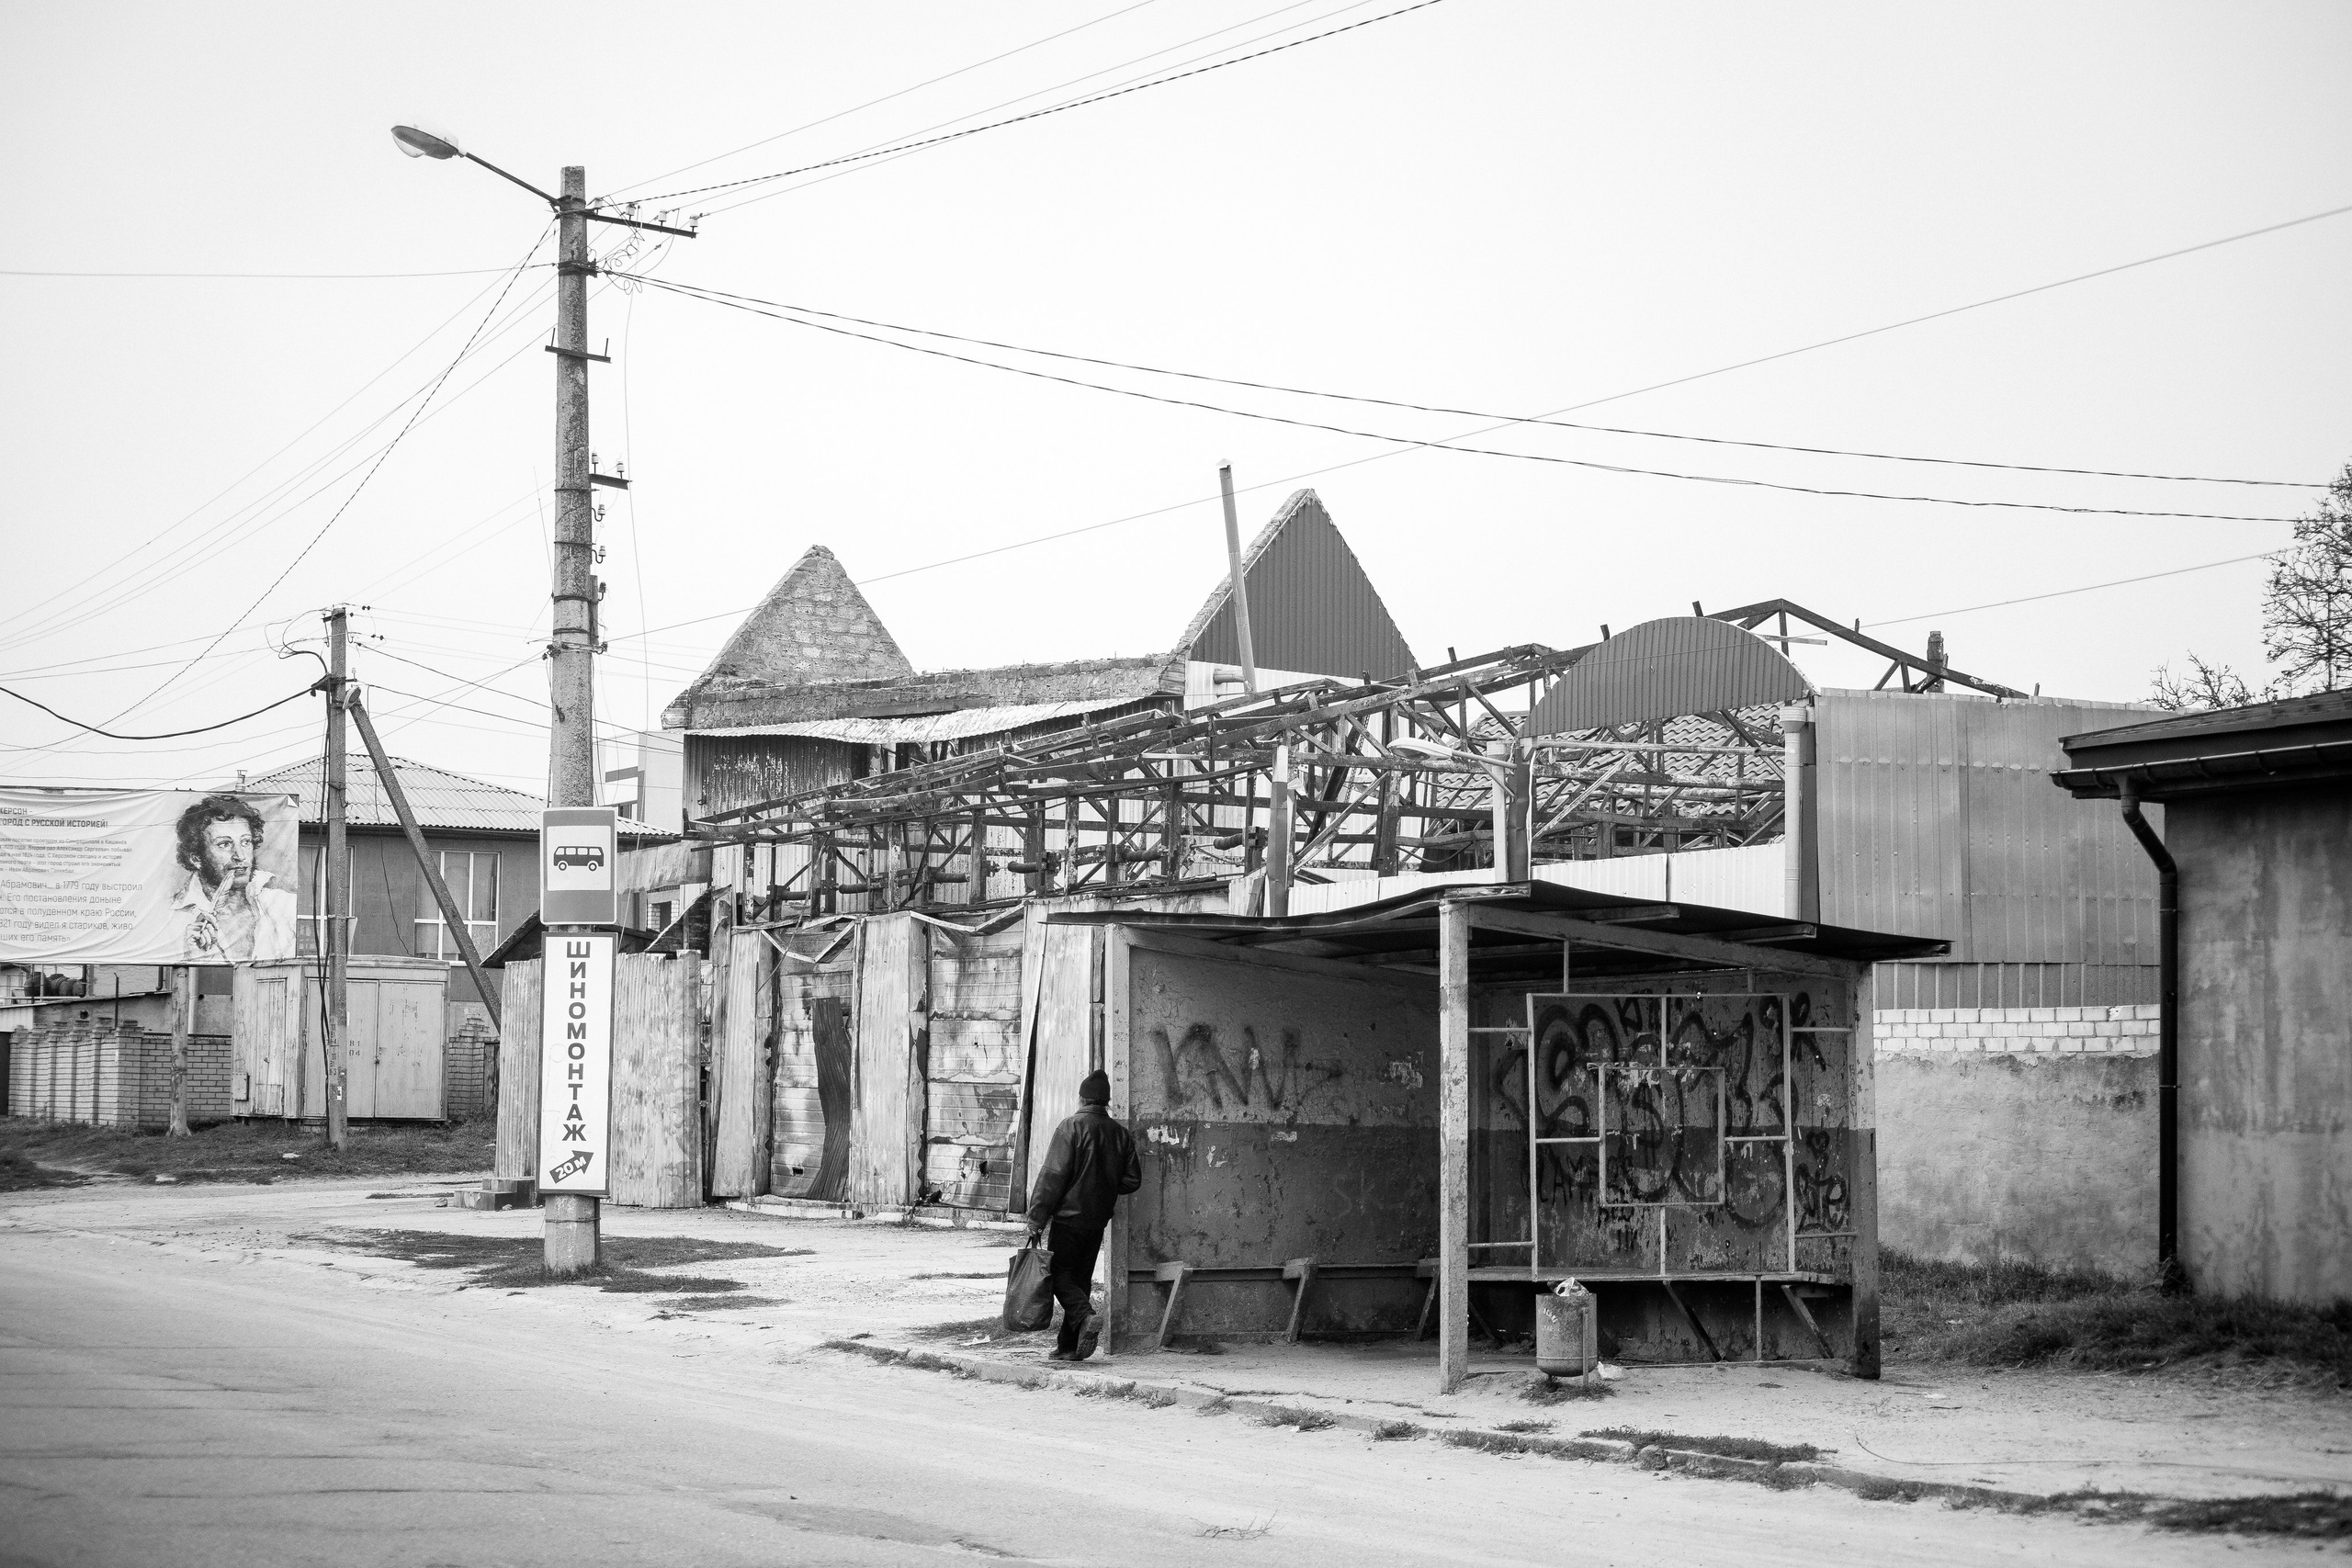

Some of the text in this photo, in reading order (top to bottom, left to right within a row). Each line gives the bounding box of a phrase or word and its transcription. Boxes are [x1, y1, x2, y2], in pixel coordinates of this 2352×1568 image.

[25, 818, 29, 827] С
[31, 818, 65, 828] РУССКОЙ
[66, 818, 108, 829] ИСТОРИЕЙ!
[55, 882, 61, 890] в
[62, 880, 79, 890] 1779
[81, 883, 99, 892] году
[101, 883, 142, 892] выстроил
[6, 892, 21, 902] Его
[23, 895, 87, 903] постановления
[89, 896, 122, 904] доныне
[27, 908, 78, 917] полуденном
[80, 908, 102, 918] краю
[105, 908, 137, 918] России,
[13, 920, 31, 930] году
[34, 920, 60, 930] видел
[68, 921, 109, 931] стариков,
[111, 922, 133, 931] живо
[20, 933, 35, 942] его
[37, 934, 72, 942] память»
[561, 941, 592, 1142] ШИНОМОНТАЖ
[555, 1156, 587, 1179] 20 М
